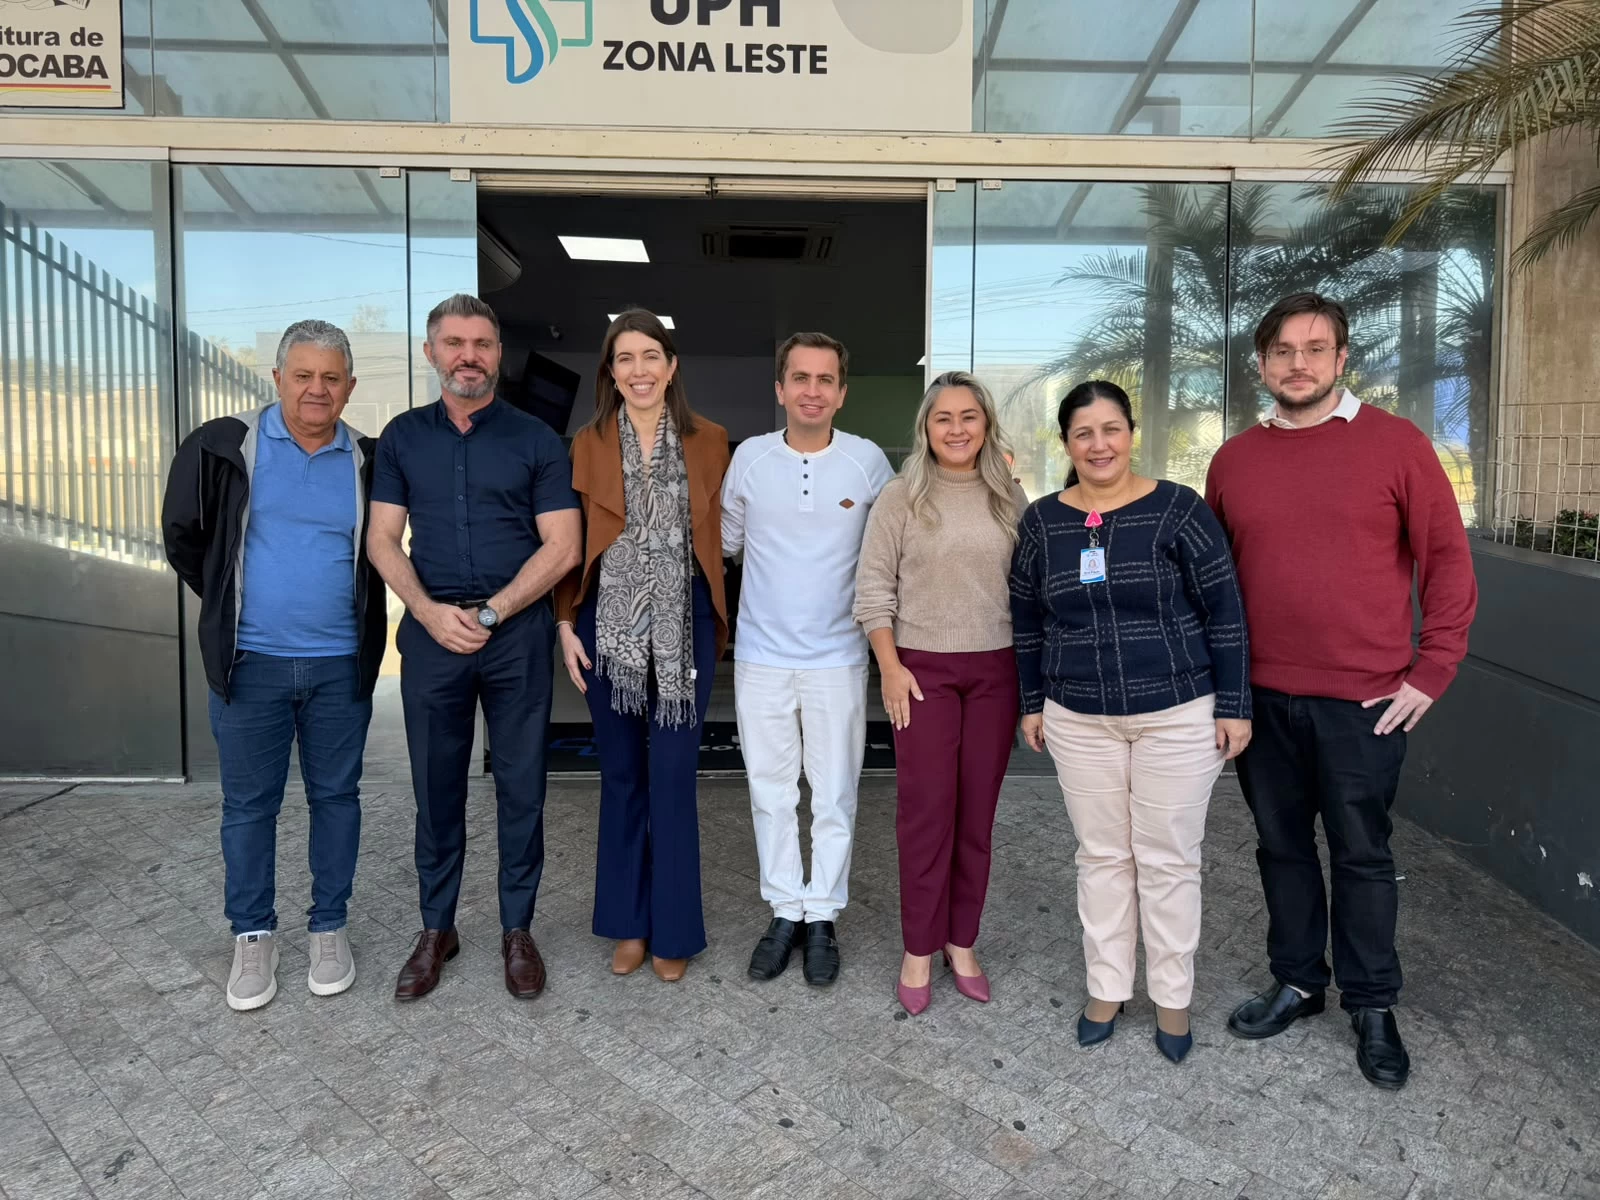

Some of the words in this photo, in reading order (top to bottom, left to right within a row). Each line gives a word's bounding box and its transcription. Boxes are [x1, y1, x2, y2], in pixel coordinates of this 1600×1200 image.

[650, 0, 781, 27] UPH
[70, 27, 104, 47] de
[603, 40, 715, 72] ZONA
[725, 43, 828, 75] LESTE
